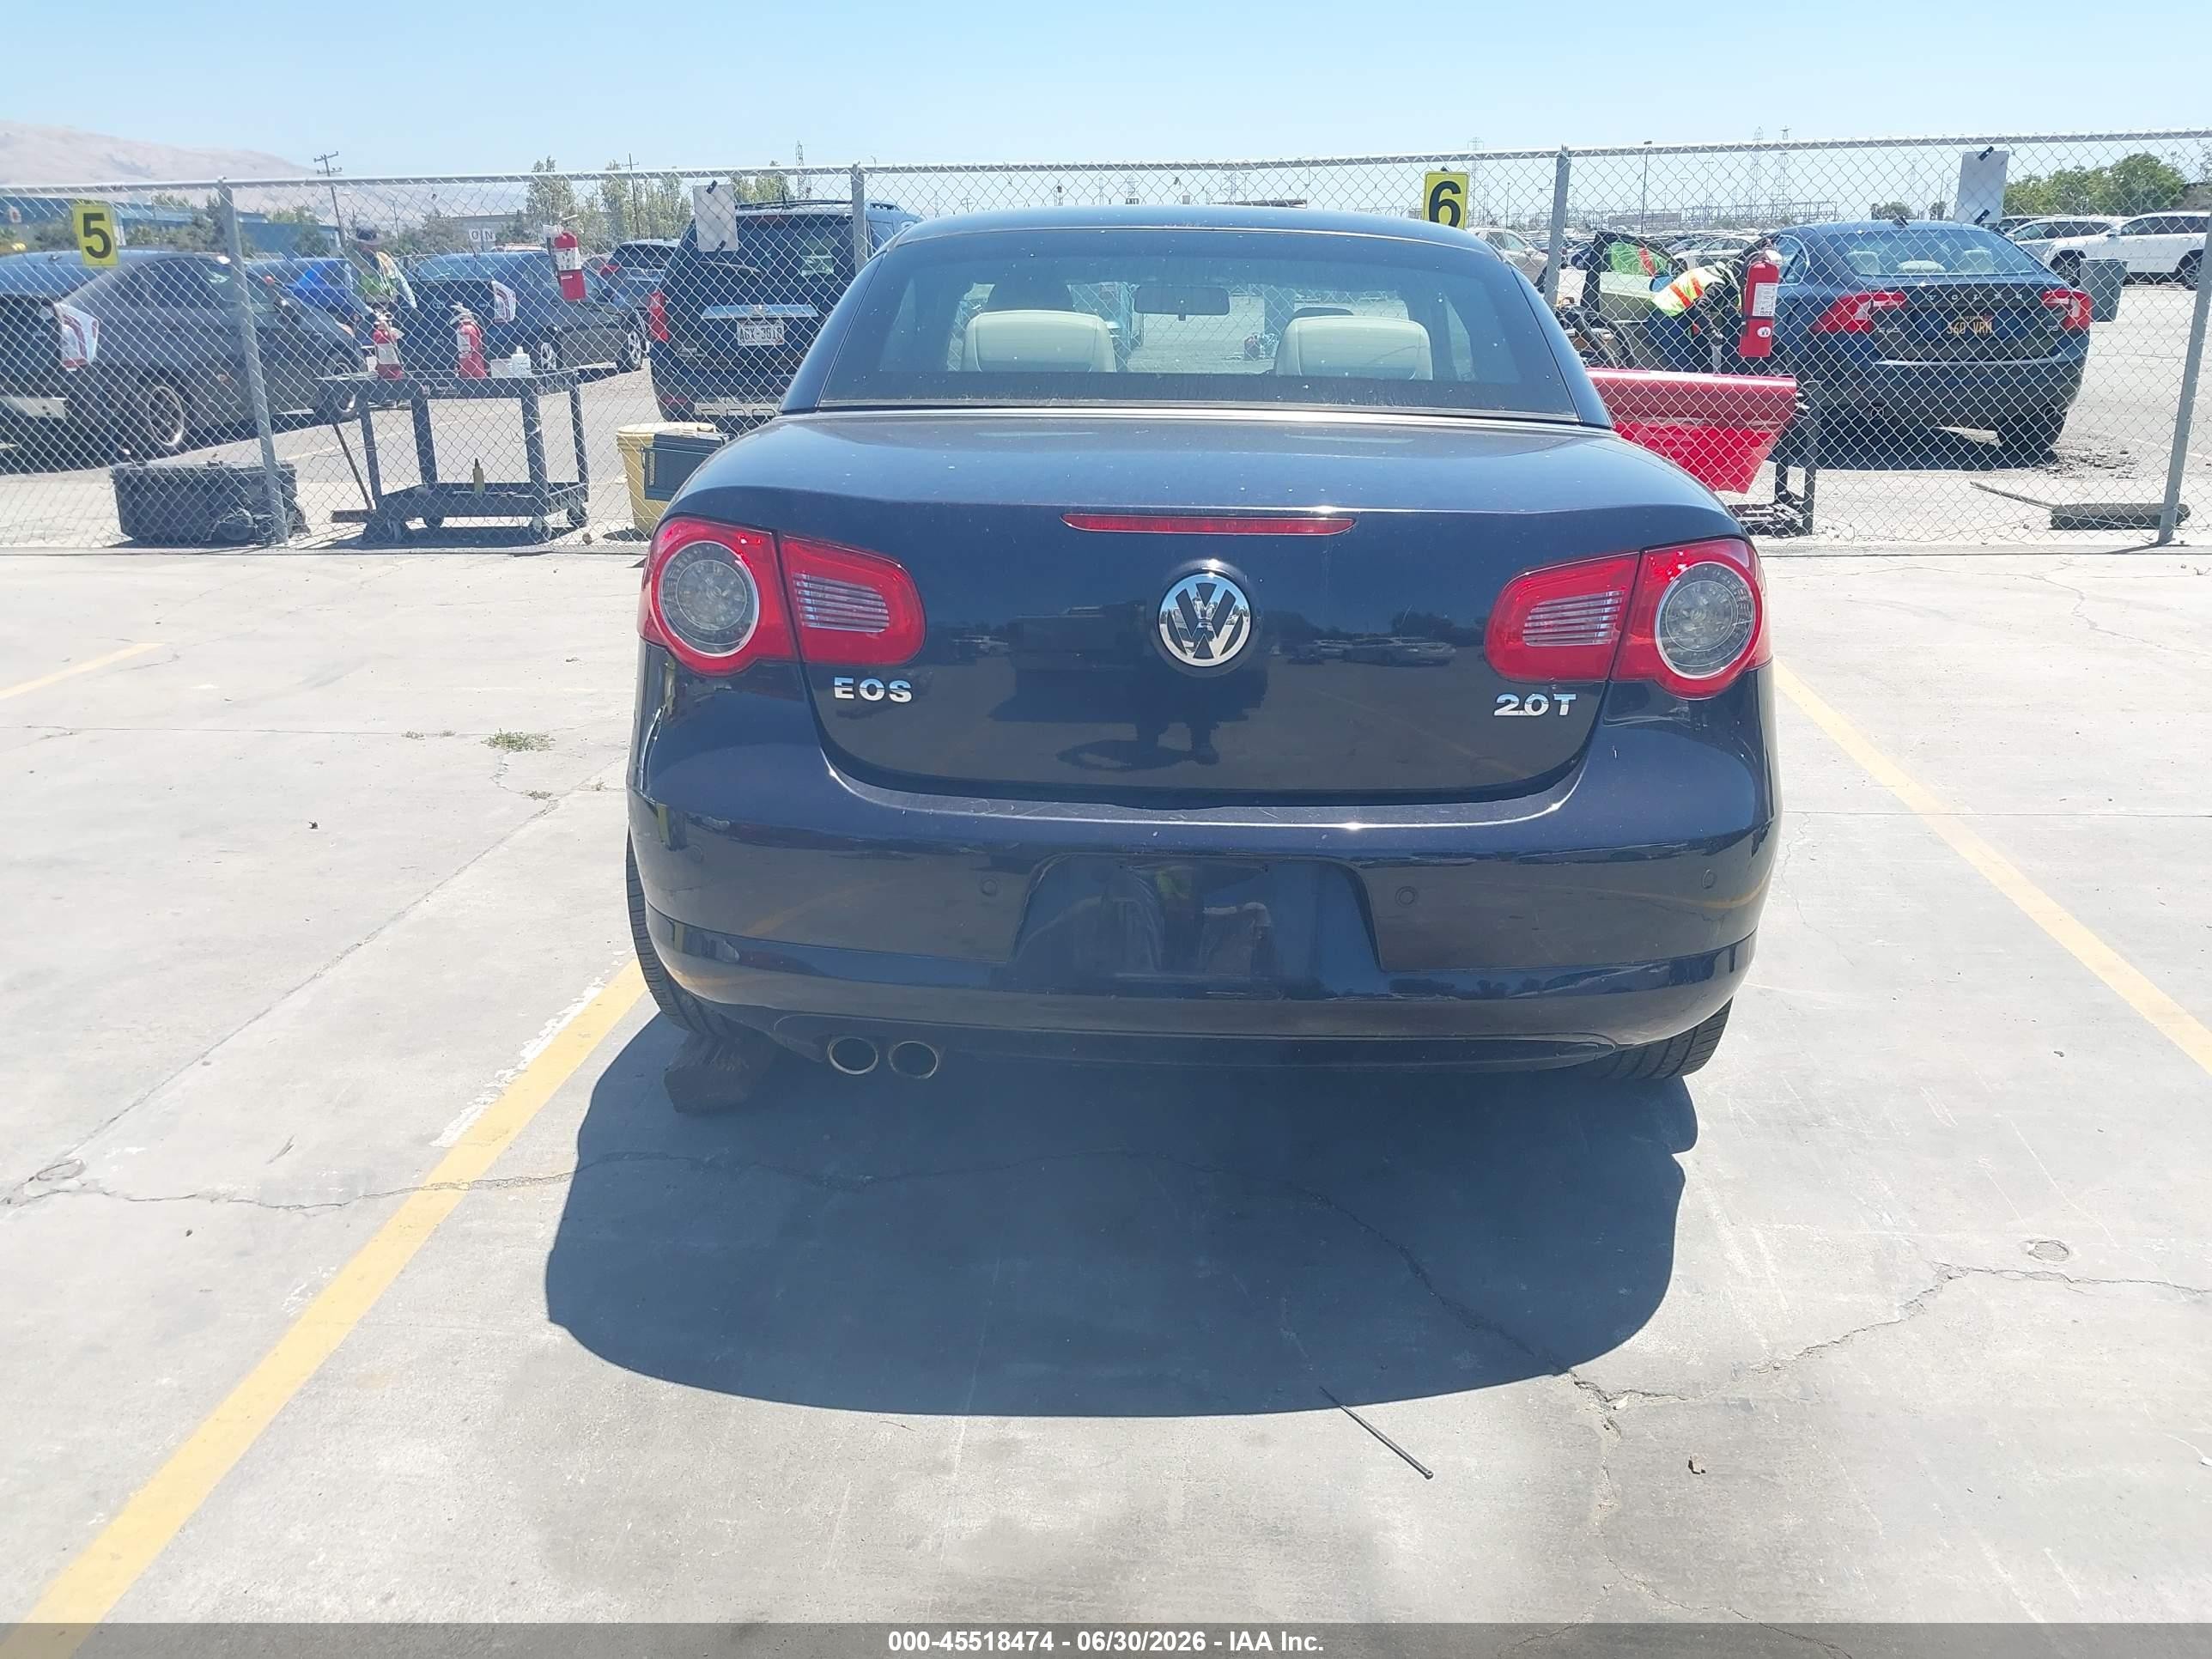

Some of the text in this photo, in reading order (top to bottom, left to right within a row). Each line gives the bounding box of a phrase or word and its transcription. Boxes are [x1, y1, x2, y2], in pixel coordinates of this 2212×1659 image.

[1429, 180, 1462, 228] 6
[83, 212, 112, 258] 5
[834, 677, 913, 703] EOS
